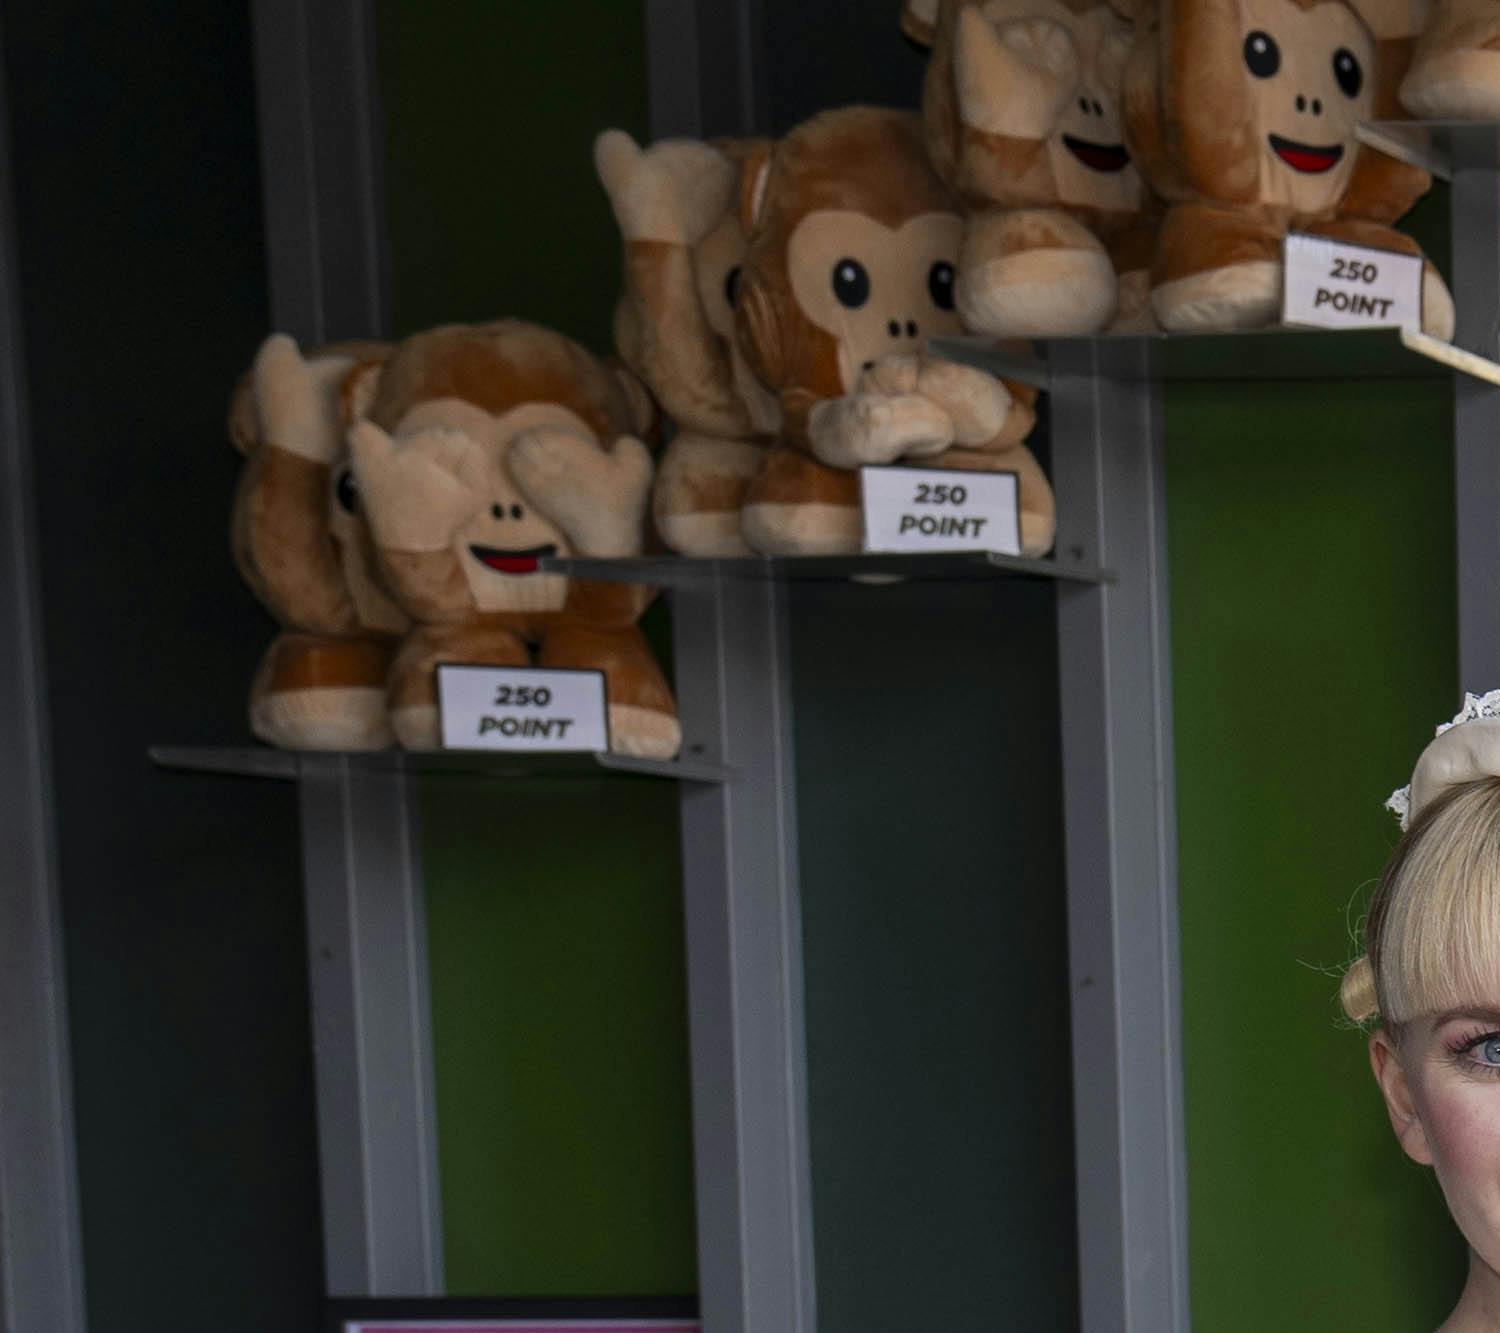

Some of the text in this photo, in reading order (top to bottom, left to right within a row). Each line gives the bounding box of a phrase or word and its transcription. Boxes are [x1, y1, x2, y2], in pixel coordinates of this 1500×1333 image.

[1329, 257, 1379, 285] 250
[1313, 287, 1395, 319] POINT
[913, 483, 969, 508] 250
[899, 515, 988, 539] POINT
[494, 685, 552, 708] 250
[478, 715, 574, 740] POINT
